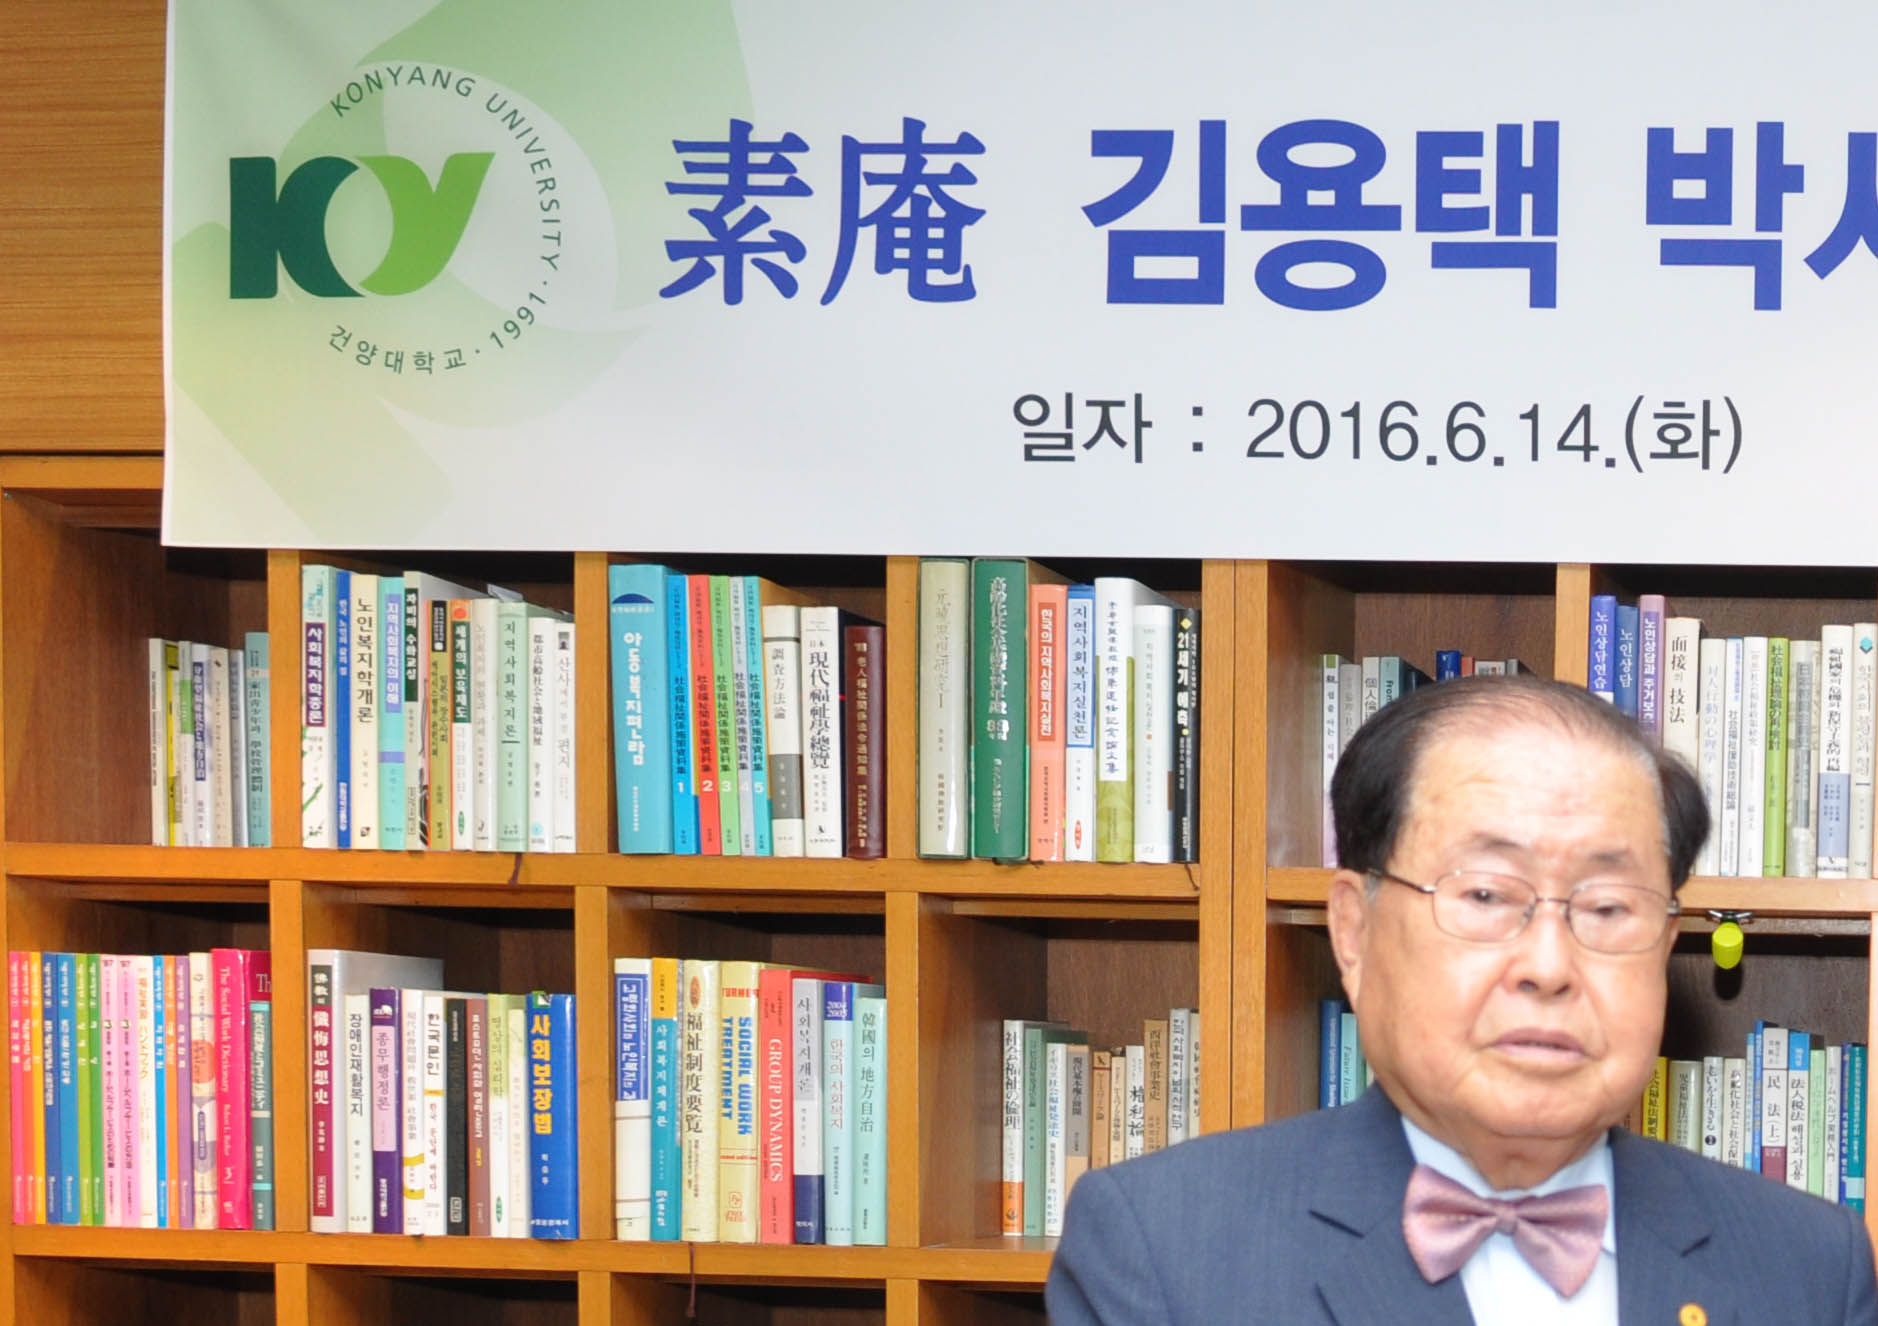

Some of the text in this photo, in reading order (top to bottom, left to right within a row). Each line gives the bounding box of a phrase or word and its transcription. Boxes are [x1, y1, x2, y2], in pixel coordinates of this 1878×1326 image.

[330, 66, 561, 271] KONYANG UNIVERSITY
[659, 117, 986, 305] 素庵
[1082, 120, 1559, 311] 김용택
[329, 325, 466, 374] 건양대학교
[489, 292, 546, 349] 1991
[1014, 393, 1152, 463] 일자
[1247, 396, 1741, 473] 2016.6.14.(화)
[357, 598, 374, 722] 노인복지학개론
[505, 621, 518, 738] 지역사회복지론
[1619, 628, 1633, 688] 노인상담
[677, 781, 685, 793] 1
[702, 780, 714, 793] 2
[721, 780, 732, 793] 3
[754, 780, 765, 793] 5
[530, 1014, 553, 1136] 사회보장법
[722, 1016, 735, 1121] TREATMENT
[738, 1016, 753, 1136] SOCIAL WORK
[860, 1066, 875, 1134] 地方自治
[768, 1037, 784, 1184] GROUP DYNAMICS
